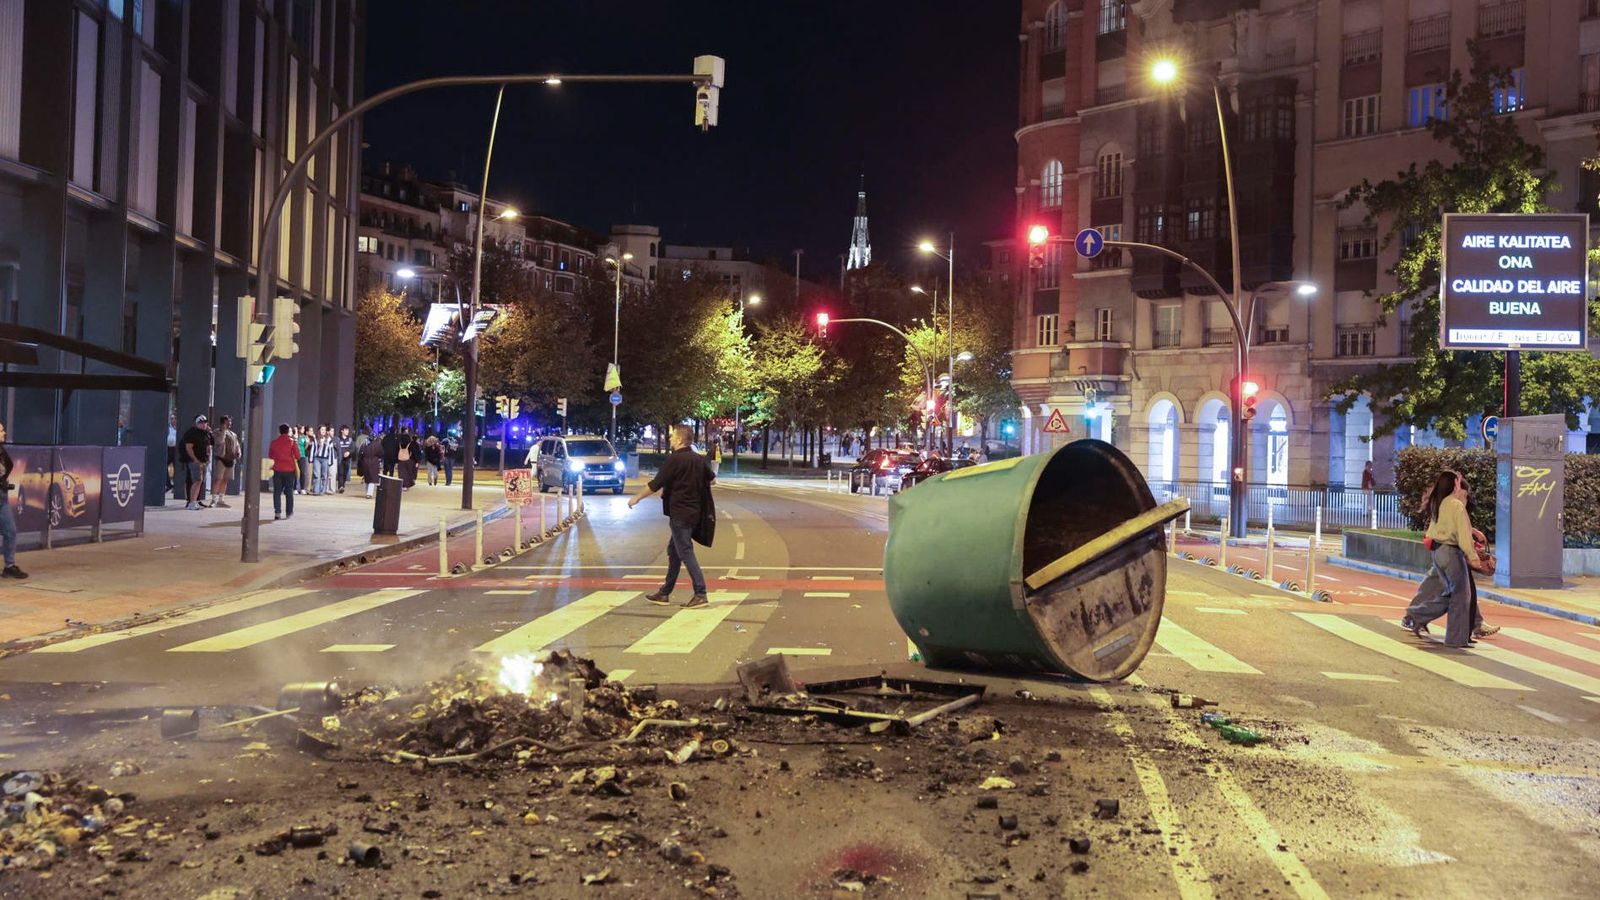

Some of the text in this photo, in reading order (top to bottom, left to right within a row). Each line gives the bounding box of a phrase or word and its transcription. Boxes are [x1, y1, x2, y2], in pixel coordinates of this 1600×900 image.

[1462, 235, 1571, 248] AIRE KALITATEA
[1499, 255, 1533, 269] ONA
[1452, 279, 1581, 294] CALIDAD DEL AIRE
[1489, 302, 1541, 315] BUENA
